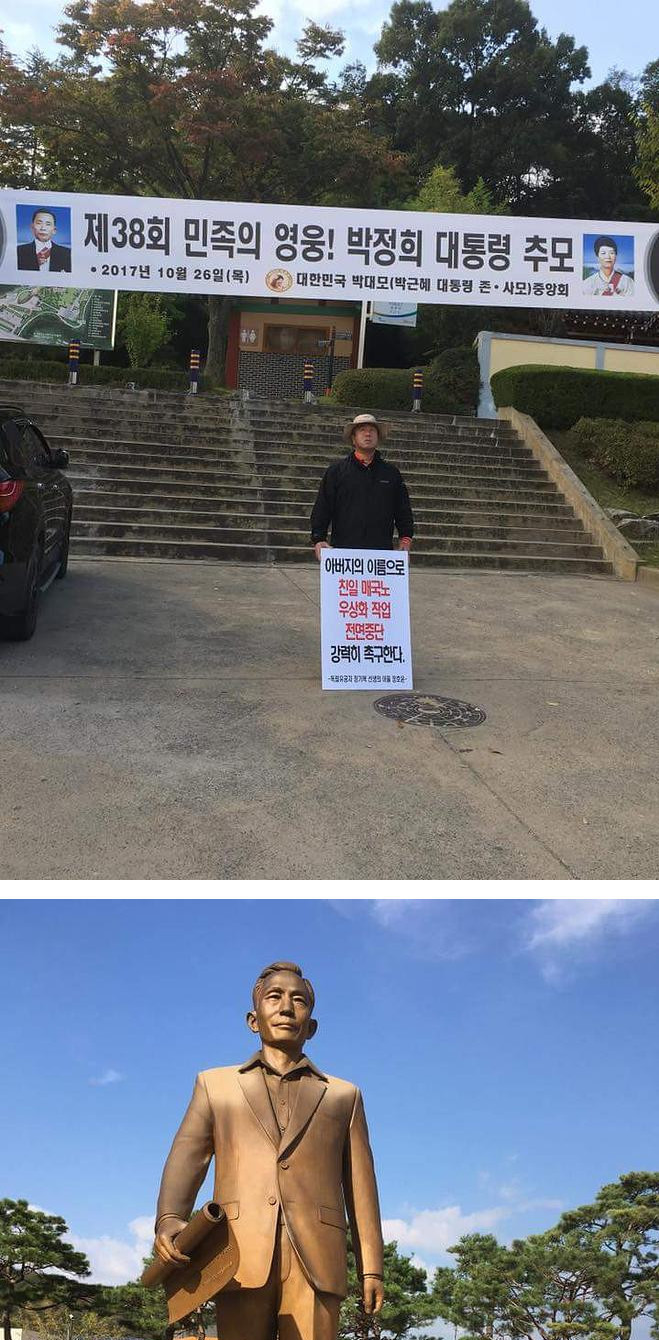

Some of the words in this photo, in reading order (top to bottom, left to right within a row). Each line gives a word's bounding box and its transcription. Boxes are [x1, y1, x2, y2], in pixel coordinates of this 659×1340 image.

[84, 212, 170, 256] 제38회
[184, 218, 261, 260] 민족의
[275, 223, 334, 262] 영웅!
[347, 228, 423, 268] 박정희
[436, 231, 511, 271] 대통령
[524, 235, 575, 273] 추모
[101, 264, 150, 279] 2017년
[158, 266, 187, 281] 10월
[194, 268, 250, 284] 26일(목)
[296, 272, 346, 288] 대한민국
[437, 278, 473, 293] 대통령
[325, 558, 364, 575] 아버지의
[367, 558, 405, 576] 이름으로
[339, 579, 358, 597] 친일
[362, 580, 391, 597] 매국노
[339, 600, 368, 619] 우상화
[371, 601, 391, 619] 작업
[345, 623, 385, 641] 전면중단
[331, 645, 361, 663] 강력히
[364, 645, 405, 664] 촉구한다.
